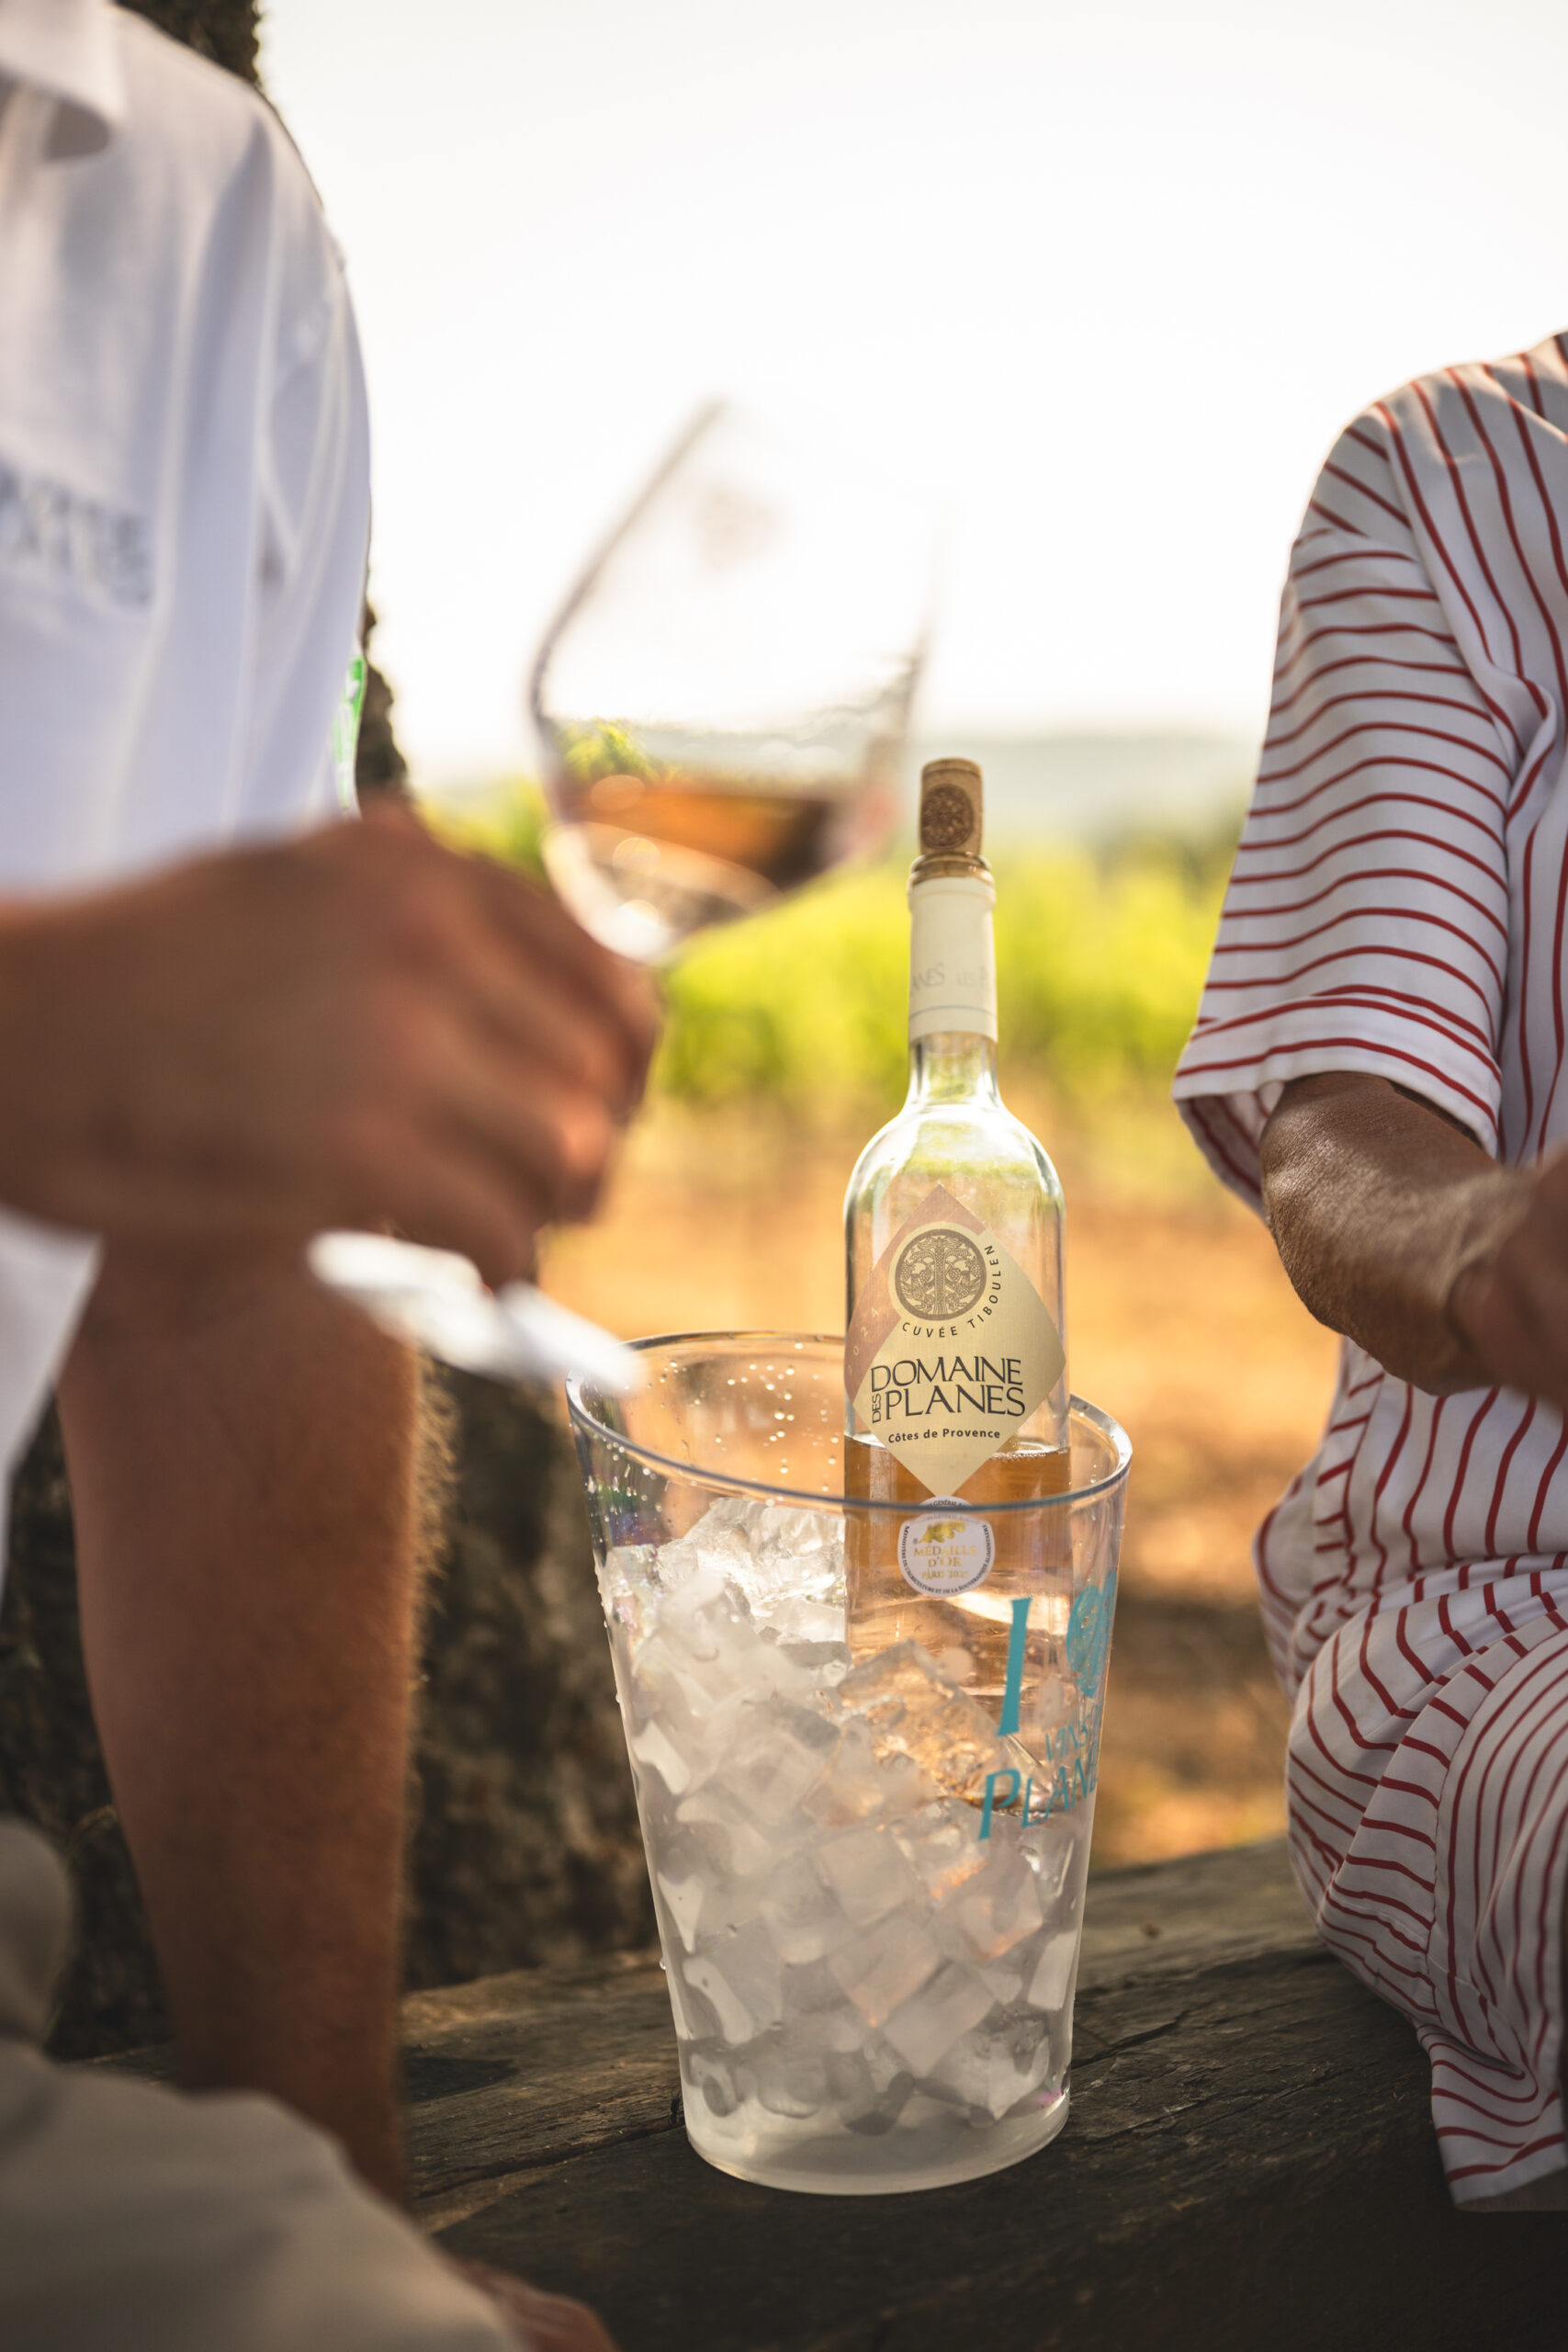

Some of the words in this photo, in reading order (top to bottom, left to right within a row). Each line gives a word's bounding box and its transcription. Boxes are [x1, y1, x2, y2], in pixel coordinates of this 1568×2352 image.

[902, 1321, 958, 1338] CUVÉE
[966, 1245, 1001, 1329] TIBOULEN
[871, 1355, 1023, 1393] DOMAINE
[872, 1393, 882, 1424] DES
[885, 1384, 1026, 1420] PLANES
[888, 1430, 919, 1443] Côtes
[923, 1429, 938, 1439] de
[942, 1428, 1000, 1439] Provence
[914, 1544, 977, 1556] MÉDAILLE
[928, 1556, 962, 1567] D'OR
